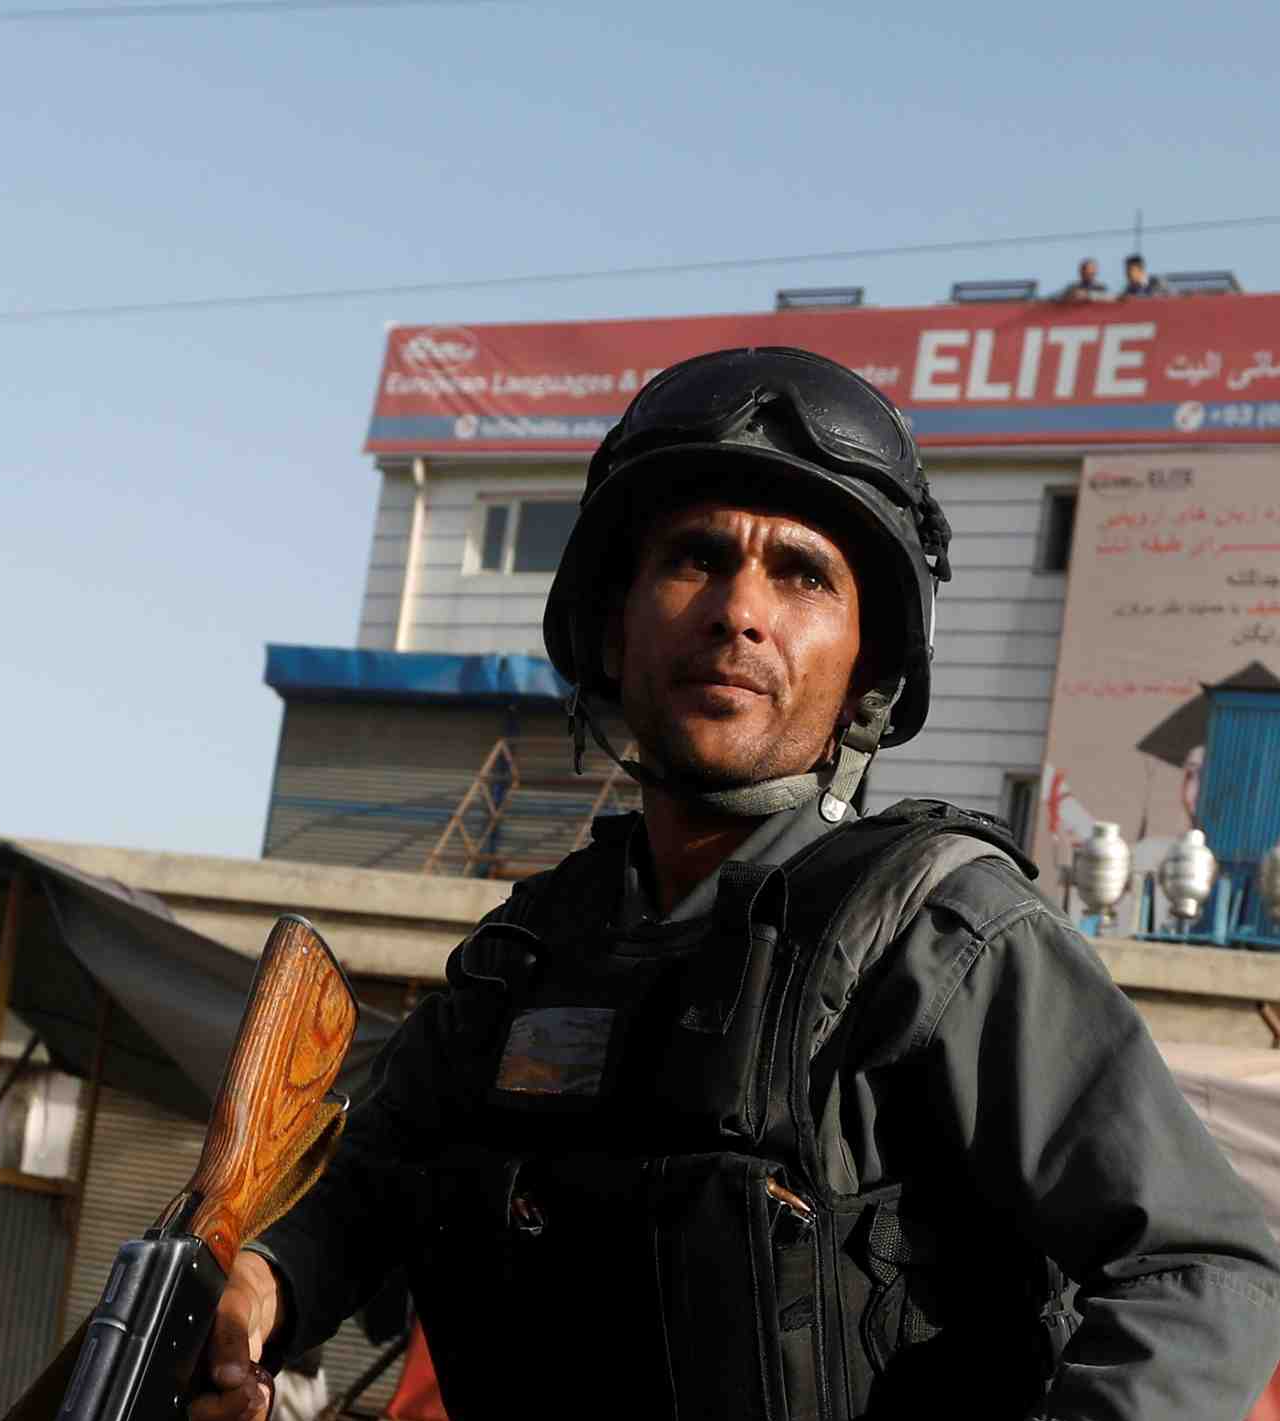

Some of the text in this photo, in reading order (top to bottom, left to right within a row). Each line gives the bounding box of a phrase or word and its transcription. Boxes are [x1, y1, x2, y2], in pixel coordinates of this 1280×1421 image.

[384, 369, 487, 397] European
[491, 368, 614, 399] Languages
[618, 366, 638, 393] &
[910, 321, 1157, 402] ELITE
